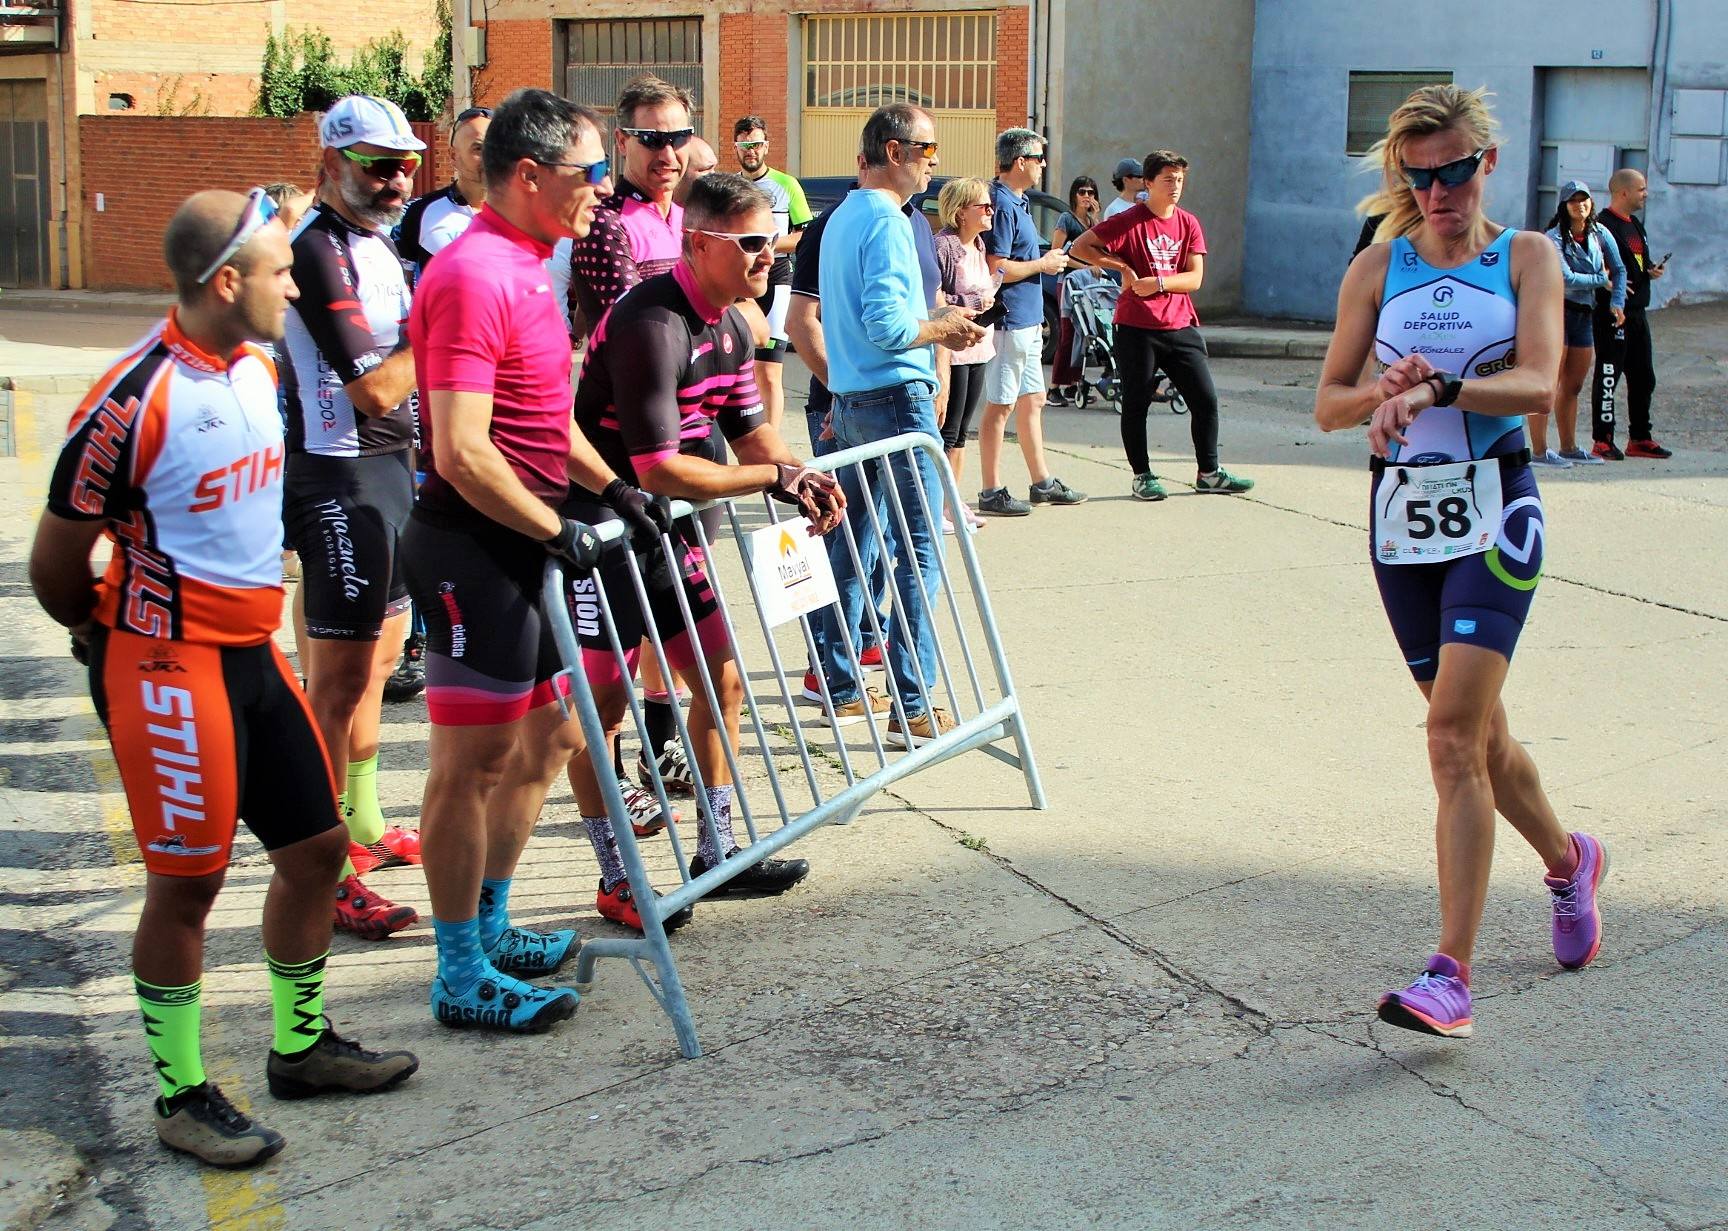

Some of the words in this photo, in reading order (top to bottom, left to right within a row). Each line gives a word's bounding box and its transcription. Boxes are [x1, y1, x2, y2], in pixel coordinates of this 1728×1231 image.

[1403, 320, 1473, 331] DEPORTIVA
[1420, 311, 1460, 321] SALUD
[1601, 363, 1615, 423] BOXEO
[72, 395, 142, 515] STIHL
[1406, 497, 1471, 540] 58
[315, 499, 369, 603] Mazuela
[321, 529, 338, 578] BODEGAS
[451, 623, 467, 658] ciclista
[141, 680, 206, 832] STIHL
